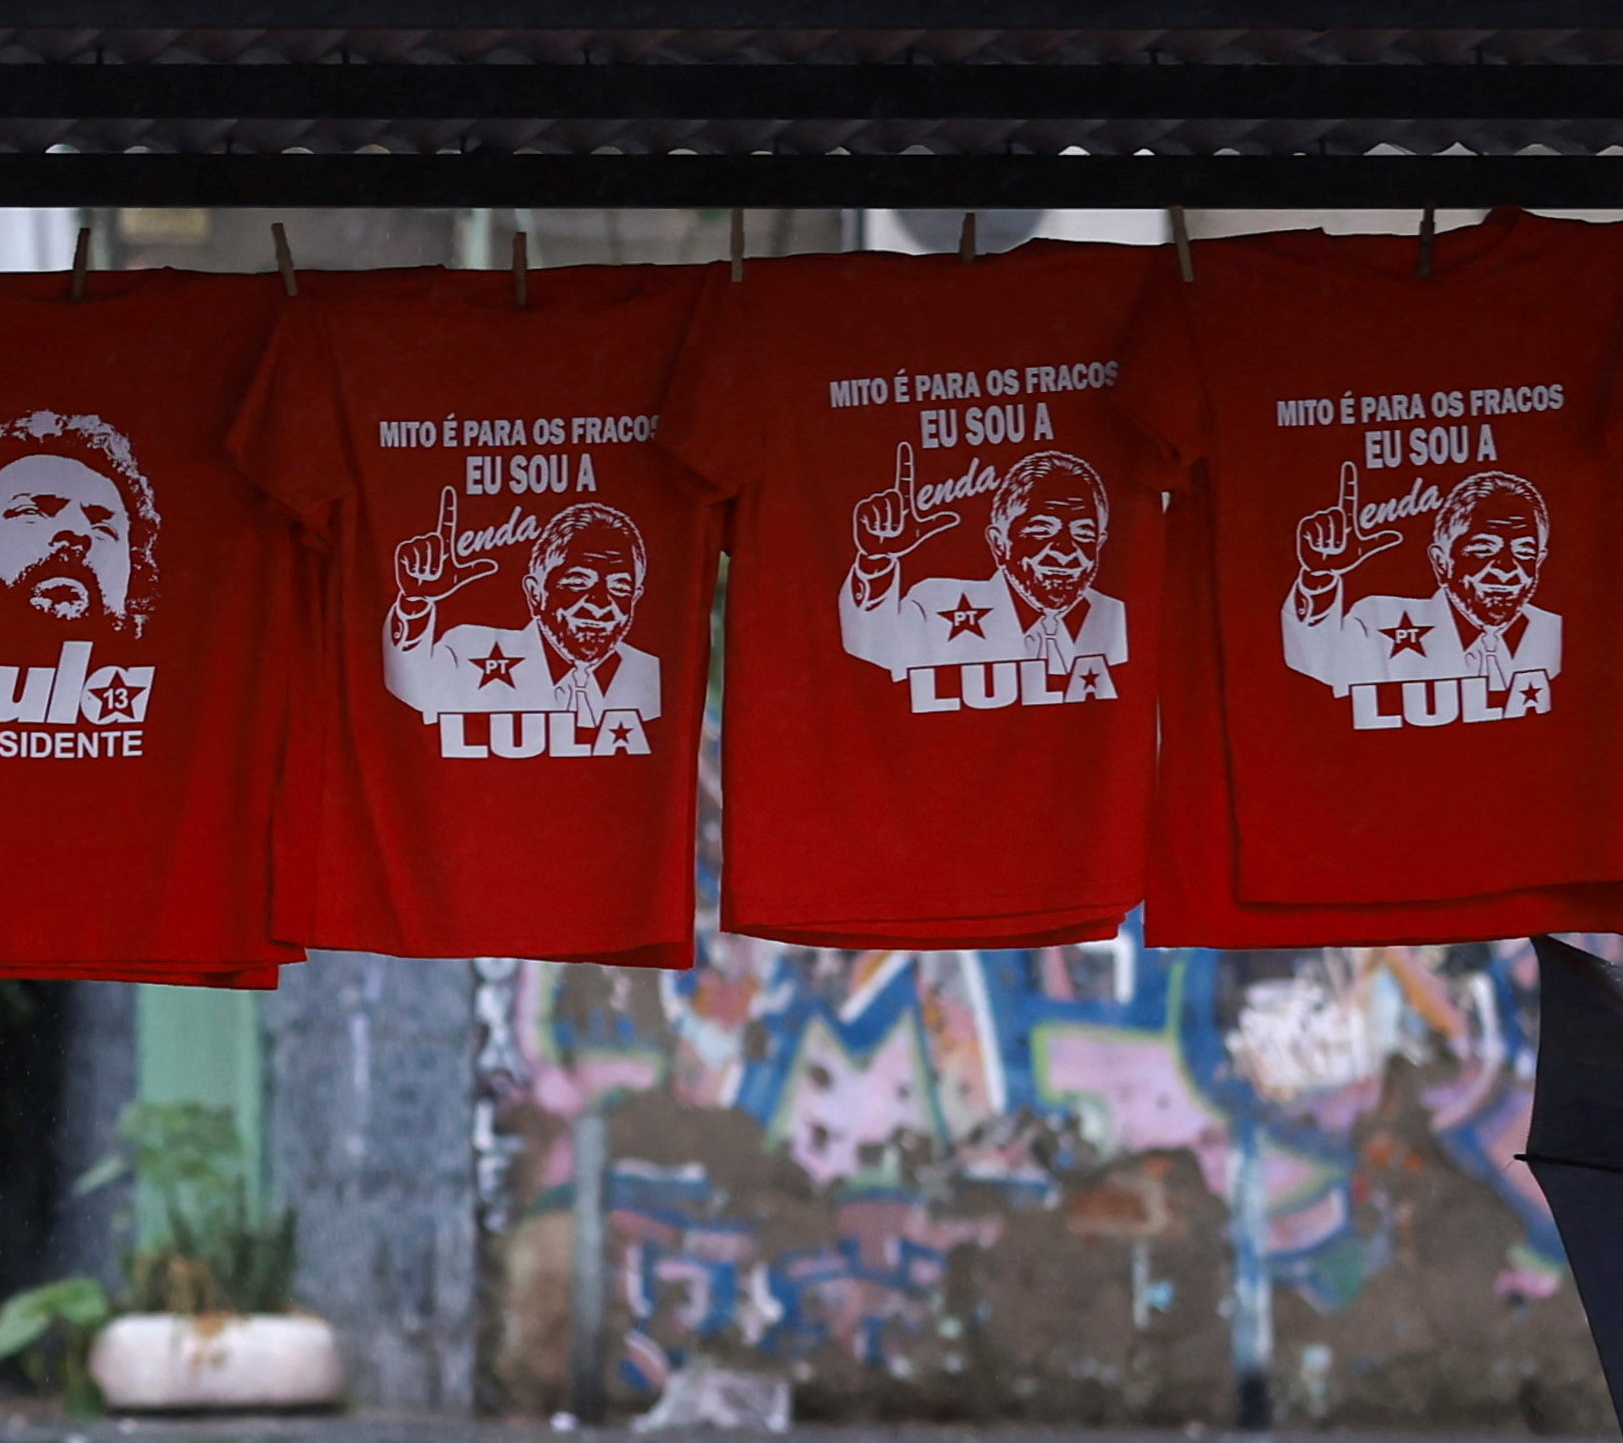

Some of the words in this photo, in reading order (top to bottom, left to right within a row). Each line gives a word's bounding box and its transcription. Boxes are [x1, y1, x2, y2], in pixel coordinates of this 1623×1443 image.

[830, 378, 887, 407] MITO
[894, 368, 909, 403] É
[915, 371, 981, 401] PARA
[986, 368, 1020, 396] OS
[1025, 360, 1119, 394] FRACOS
[920, 409, 958, 449] EU
[965, 405, 1025, 446] SOU
[1033, 402, 1053, 440] A
[1277, 399, 1334, 426] MITO
[1341, 391, 1355, 424] É
[1361, 393, 1425, 423] PARA
[1432, 391, 1465, 418] OS
[1470, 384, 1564, 416] FRACOS
[379, 421, 436, 447] MITO
[443, 413, 457, 447] É
[463, 419, 526, 446] PARA
[533, 418, 565, 445] OS
[1365, 430, 1401, 469] EU
[1409, 425, 1469, 466] SOU
[1477, 424, 1497, 461] A
[466, 456, 502, 495] EU
[509, 454, 568, 494] SOU
[576, 453, 597, 492] A
[953, 610, 977, 626] PT
[1395, 628, 1419, 644] PT
[484, 659, 509, 675] PT
[909, 655, 1118, 714] LULA
[103, 688, 128, 709] 13
[1350, 670, 1551, 730] LULA
[439, 709, 651, 759] LULA
